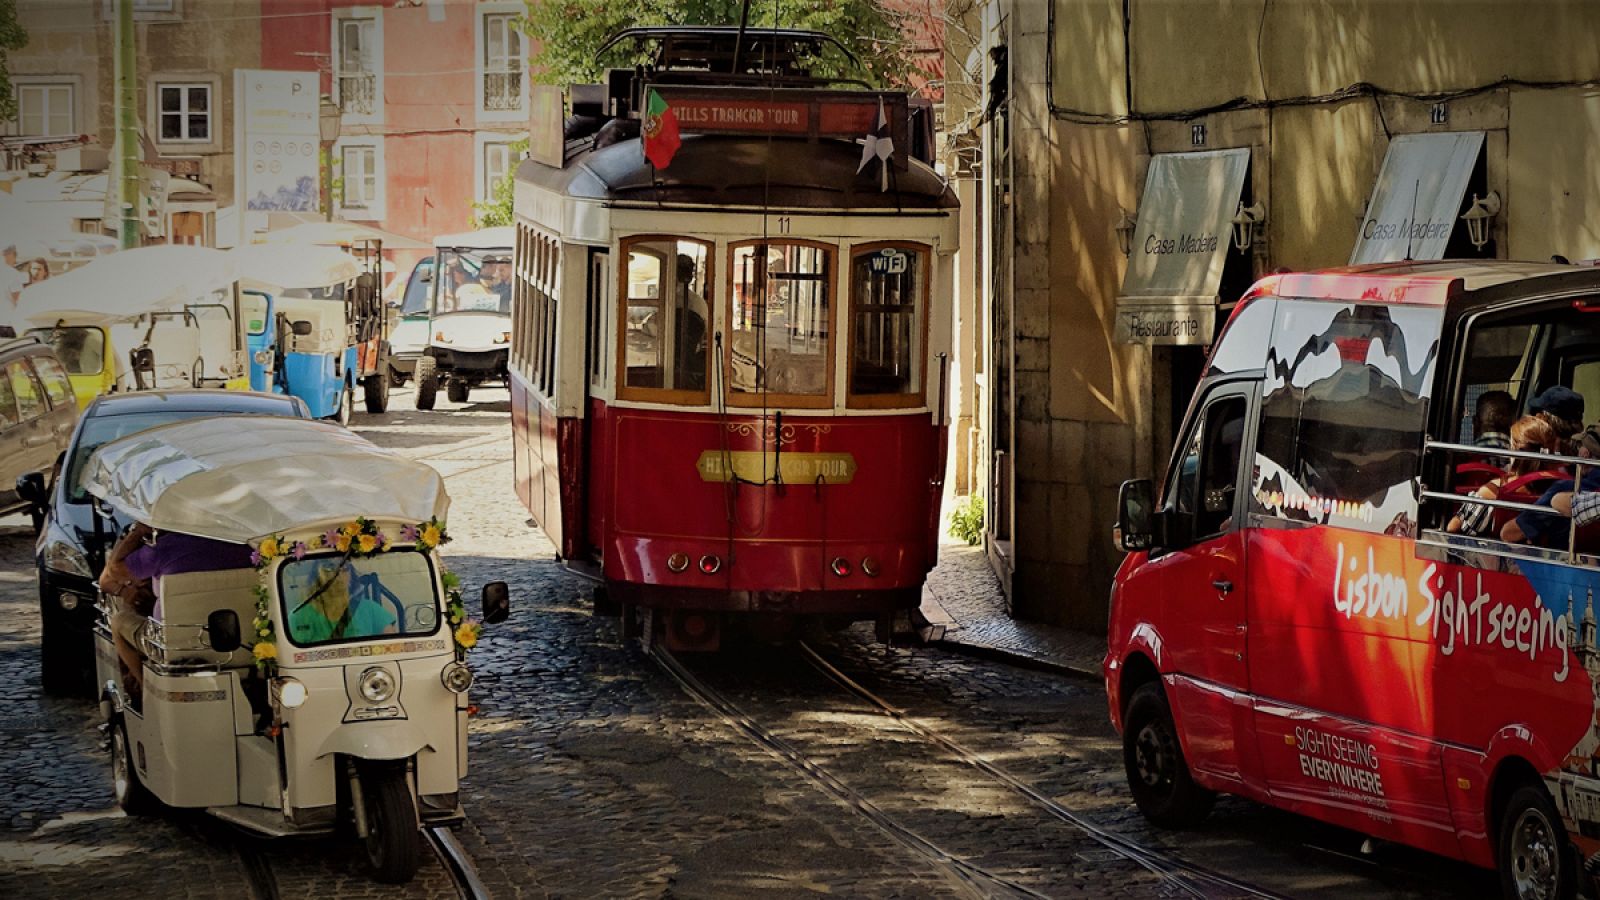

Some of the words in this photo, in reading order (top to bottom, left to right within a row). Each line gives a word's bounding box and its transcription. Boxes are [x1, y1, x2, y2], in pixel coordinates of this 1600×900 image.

[292, 82, 302, 96] P
[672, 106, 708, 122] HILLS
[768, 108, 799, 124] TOUR
[778, 217, 790, 234] 11
[1364, 218, 1397, 240] Casa
[1399, 217, 1449, 240] Madeira
[1144, 234, 1175, 255] Casa
[1178, 233, 1218, 254] Madeira
[1130, 315, 1198, 337] Restaurante
[705, 456, 748, 474] HIS
[815, 459, 848, 477] TOUR
[1333, 542, 1408, 620] Lisbon
[1415, 562, 1569, 683] Sightseeing
[1295, 725, 1379, 770] SIGHTSEEING
[1299, 753, 1385, 797] EVERYWHERE
